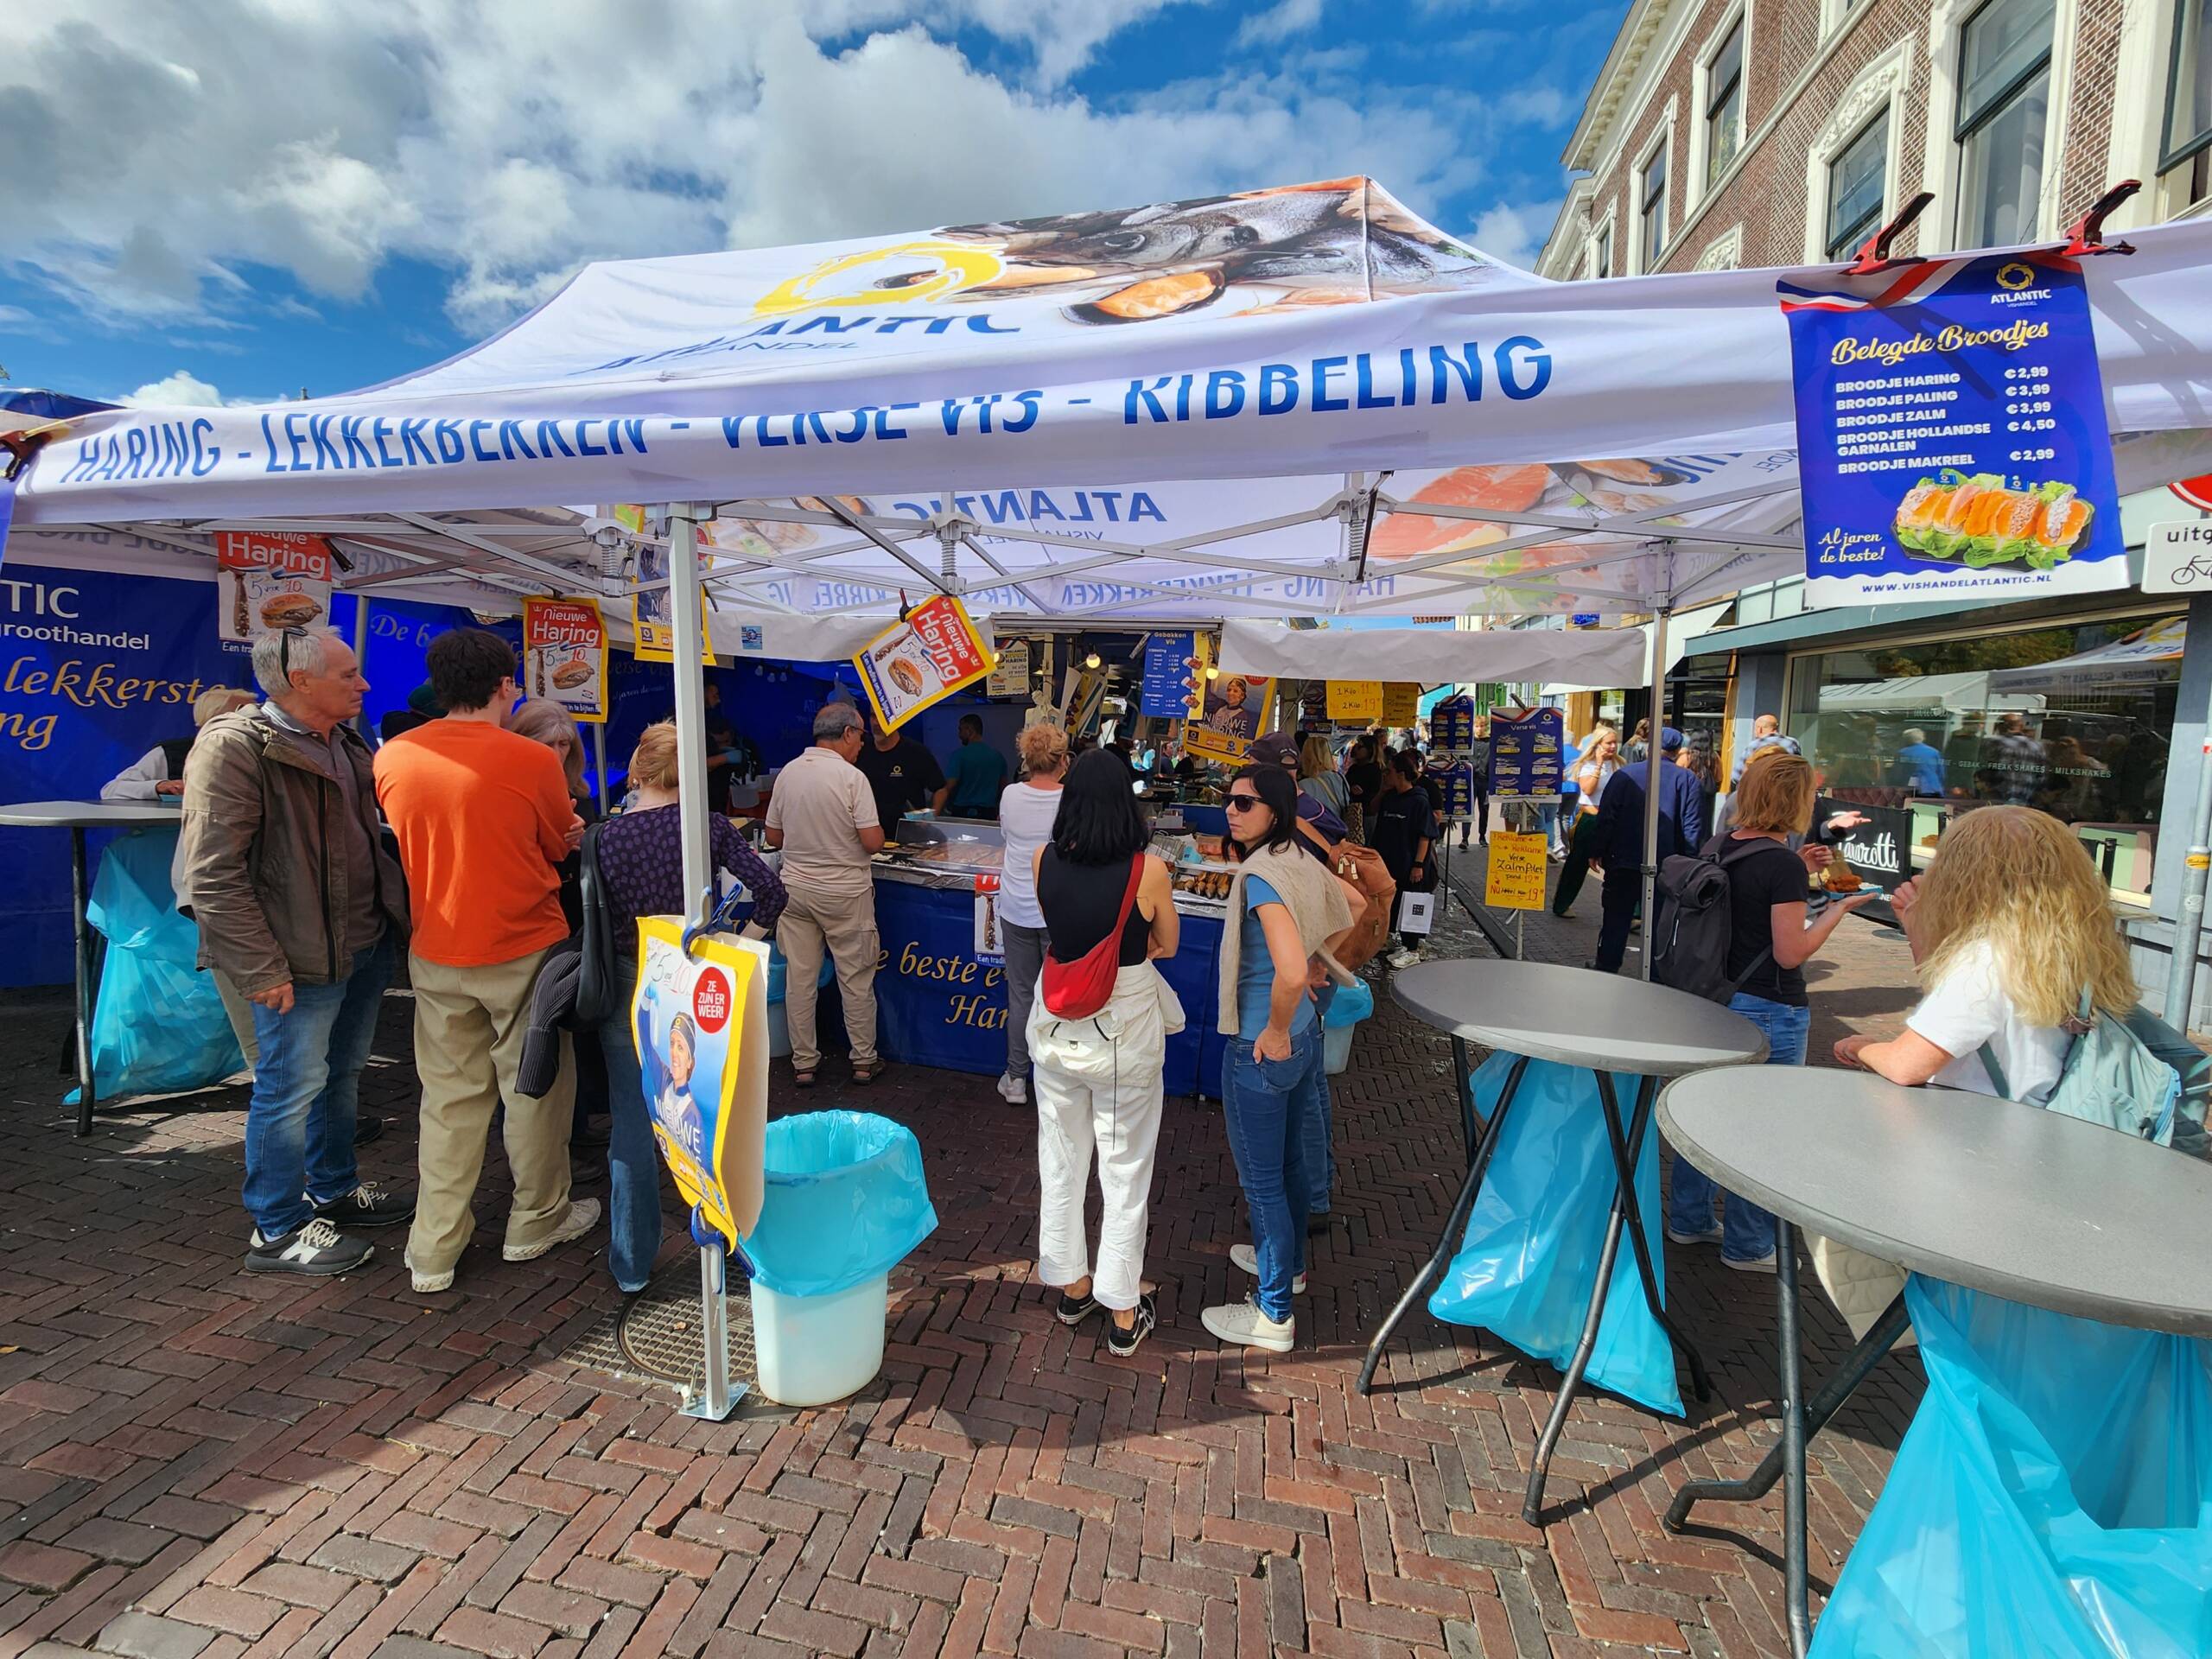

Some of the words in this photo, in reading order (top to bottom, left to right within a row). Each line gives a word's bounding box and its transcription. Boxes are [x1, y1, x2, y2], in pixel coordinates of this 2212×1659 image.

[1991, 289, 2051, 304] ATLANTIC
[1831, 333, 1935, 365] Belegde
[1937, 320, 2049, 351] Broodjes
[1836, 378, 1902, 392] BROODJE
[1904, 373, 1961, 387] HARING
[2018, 366, 2049, 378] 2,99
[60, 417, 220, 483] HARING
[261, 413, 648, 473] LEKKERBEKKEN
[1123, 334, 1554, 424] KIBBELING
[1836, 396, 1904, 410] BROODJE
[1905, 391, 1958, 404] PALING
[2018, 384, 2050, 396] 3,99
[1837, 412, 1904, 427] BROODJE
[1906, 409, 1946, 420] ZALM
[2019, 402, 2051, 414] 3,99
[1837, 429, 1904, 444] BROODJE
[1907, 423, 1990, 438] HOLLANDSE
[2022, 419, 2056, 431] 4,50
[1838, 441, 1916, 456] GARNALEN
[1839, 459, 1906, 474] BROODJE
[1908, 454, 1974, 467] MAKREEL
[2024, 448, 2055, 461] 2,99
[1818, 527, 1840, 544] Al
[1840, 532, 1882, 550] jaren
[227, 533, 327, 578] Haring
[1820, 547, 1836, 563] de
[1840, 546, 1886, 563] beste!
[1862, 574, 2052, 593] WWW.VISHANDELATLANTIC.NL
[371, 614, 409, 641] De
[533, 620, 600, 646] Haring
[918, 610, 961, 682] Haring
[1203, 711, 1248, 731] NIEUWE
[1958, 760, 1980, 769] GEBAK
[1987, 762, 2012, 772] FREAK
[2013, 764, 2045, 773] SHAKES
[2055, 766, 2112, 779] MILKSHAKES
[874, 948, 889, 971] e
[899, 941, 978, 983] beste
[985, 963, 1009, 988] e
[707, 980, 716, 993] ZE
[697, 1004, 724, 1019] WEER!
[715, 993, 725, 1006] ER
